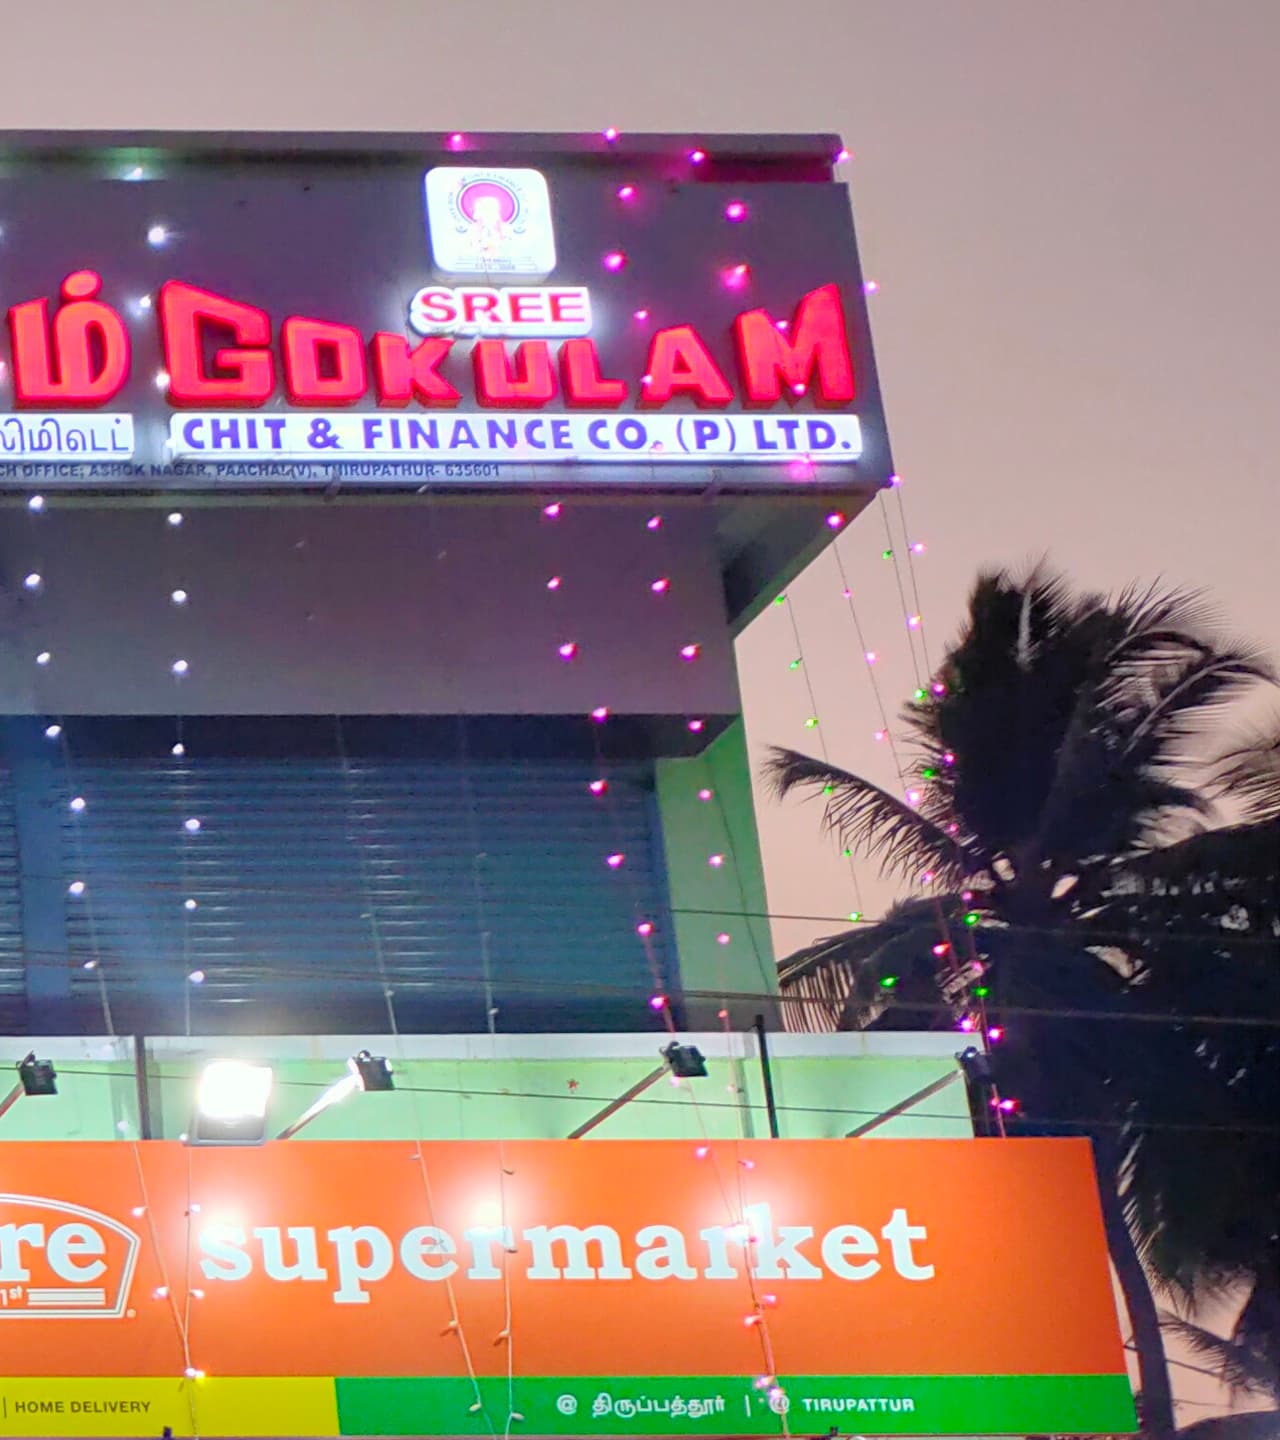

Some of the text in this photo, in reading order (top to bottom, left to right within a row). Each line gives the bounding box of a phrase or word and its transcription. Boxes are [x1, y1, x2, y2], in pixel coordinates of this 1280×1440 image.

[419, 291, 587, 325] SREE
[158, 280, 855, 409] GOKULAM
[182, 417, 851, 453] CHIT & FINANCE CO. (P) LTD.
[89, 463, 146, 478] ASHOK
[444, 463, 500, 478] 635601
[196, 1203, 936, 1305] supermarket
[0, 1285, 24, 1307] 1st
[15, 1400, 153, 1414] HOME DELIVERY
[801, 1397, 916, 1413] TIRUPATTUR
